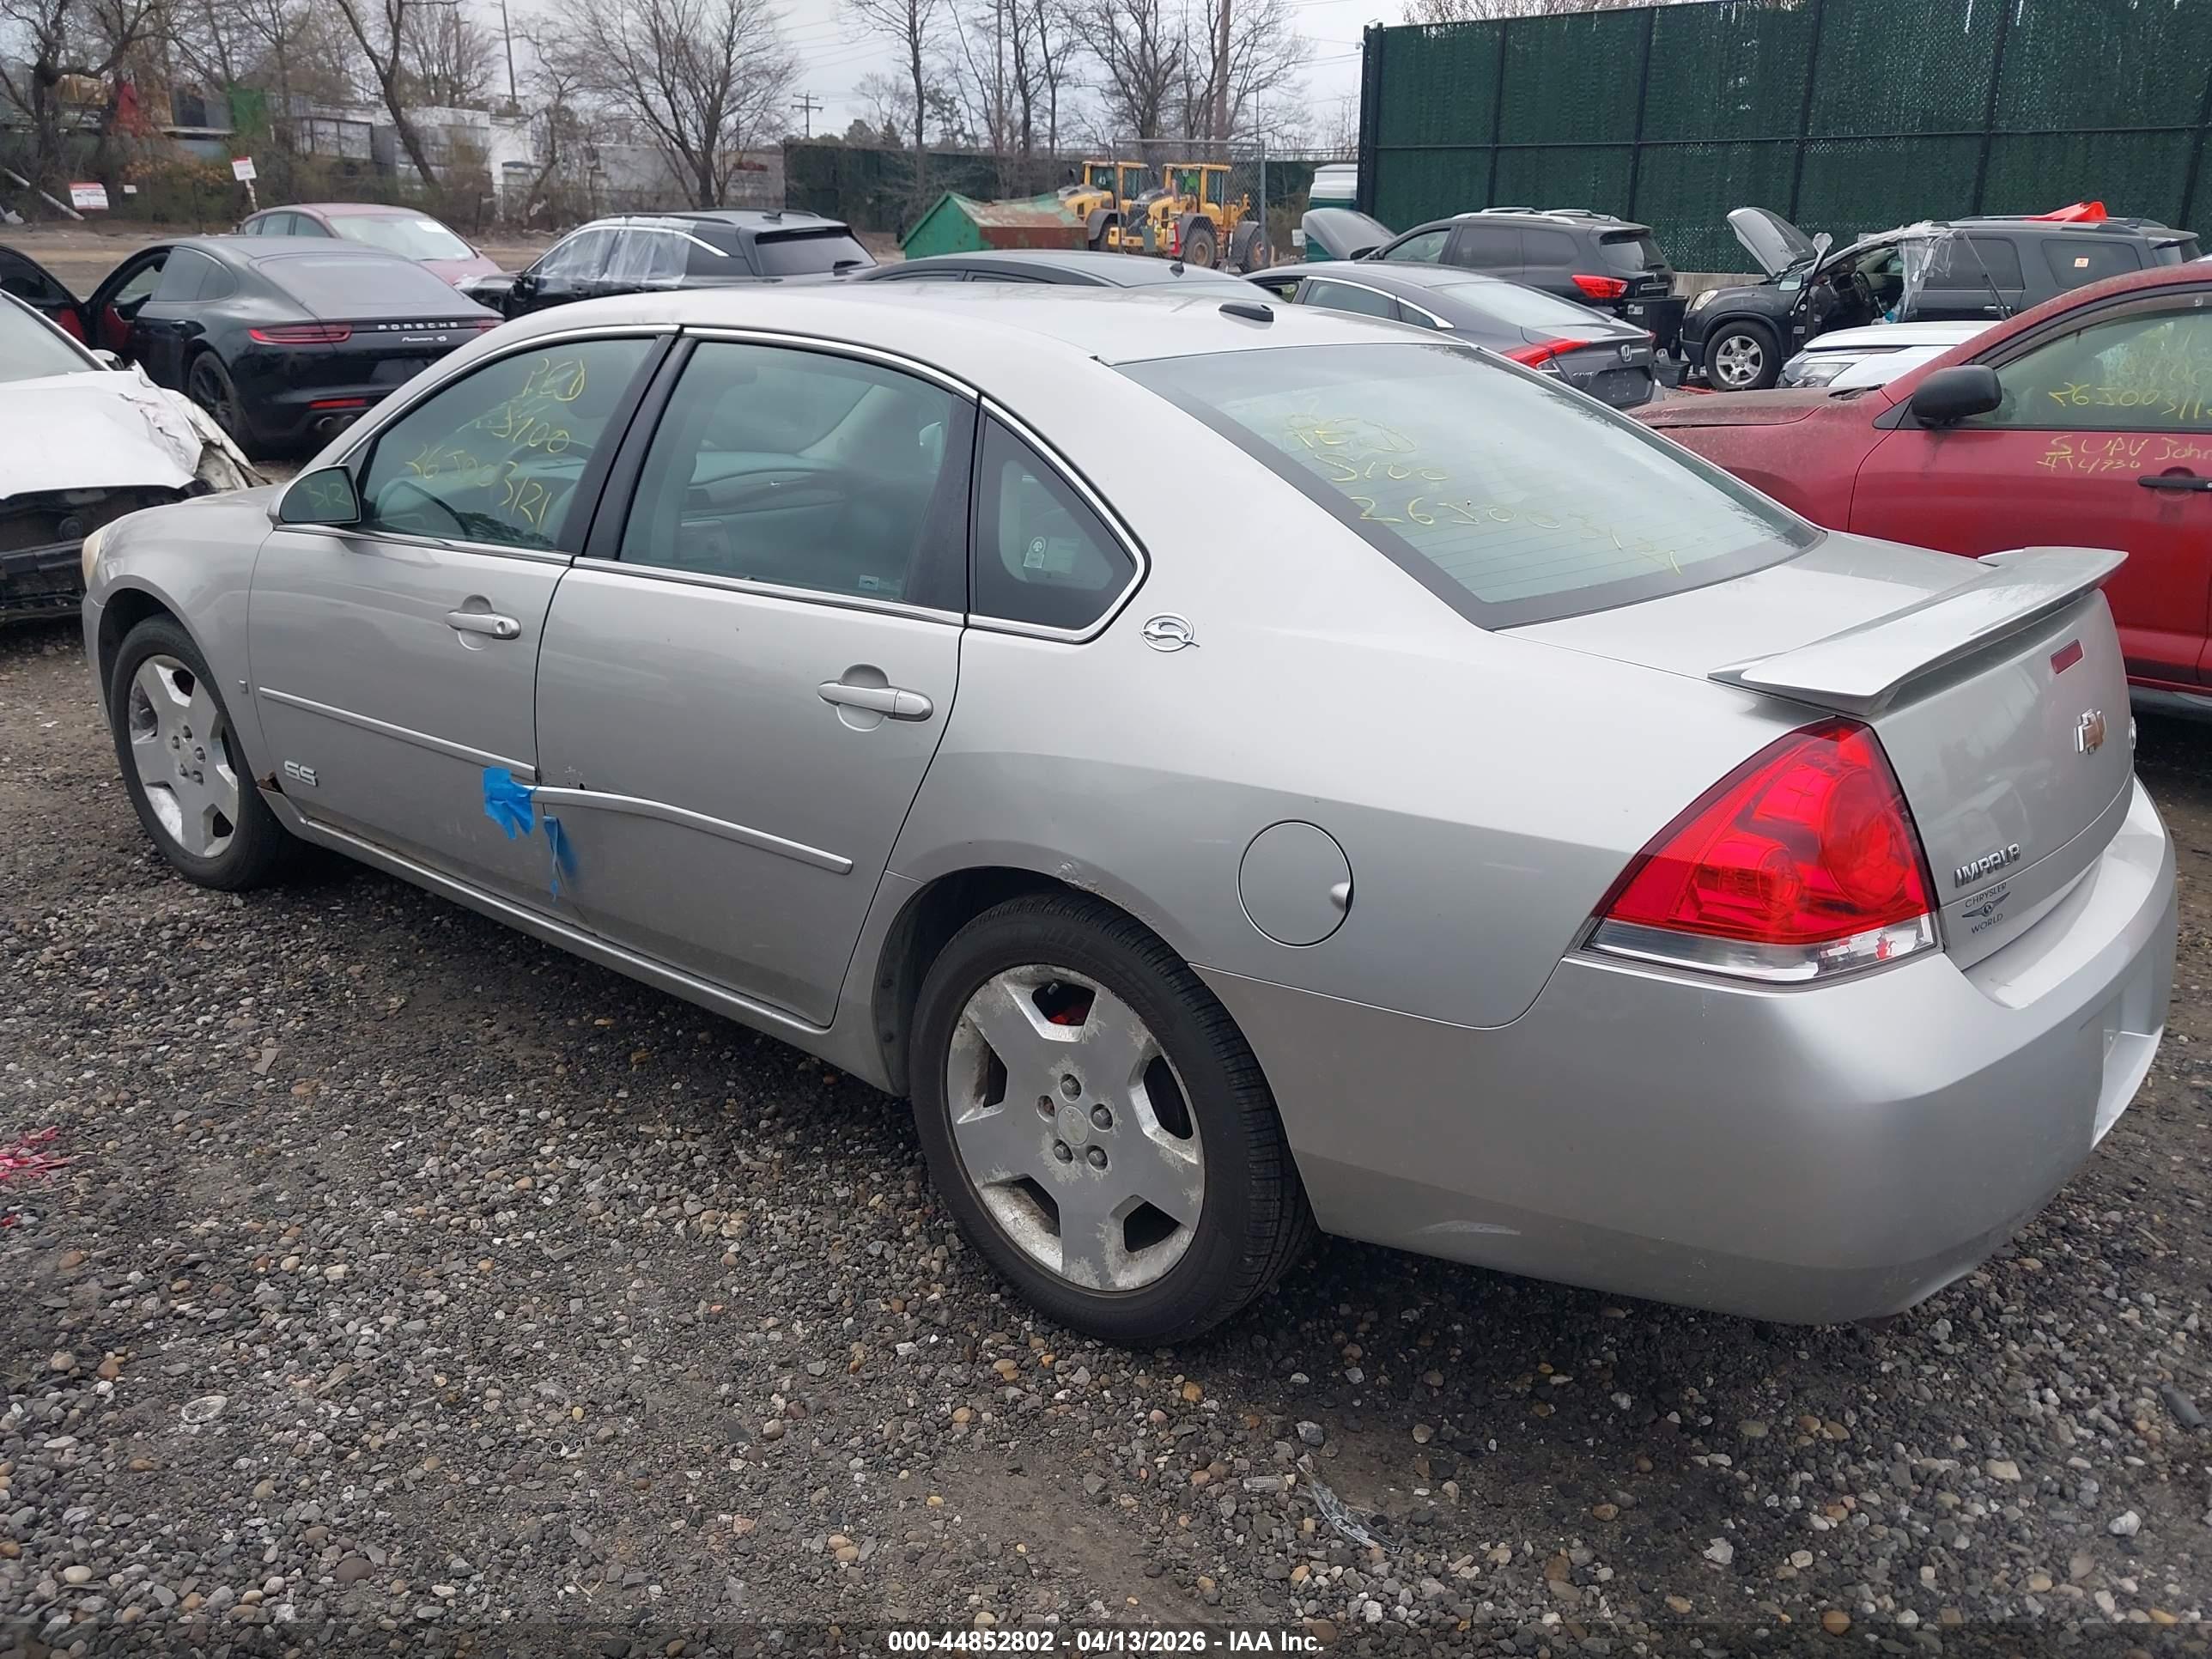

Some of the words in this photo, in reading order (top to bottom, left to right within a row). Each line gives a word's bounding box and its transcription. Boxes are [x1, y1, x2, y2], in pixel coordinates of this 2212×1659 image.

[378, 322, 458, 331] PORSCHE
[283, 759, 318, 787] SS
[1955, 842, 2021, 884] IMPALA
[1965, 882, 2007, 908] CHRYSLER
[1971, 913, 2004, 933] WORLD
